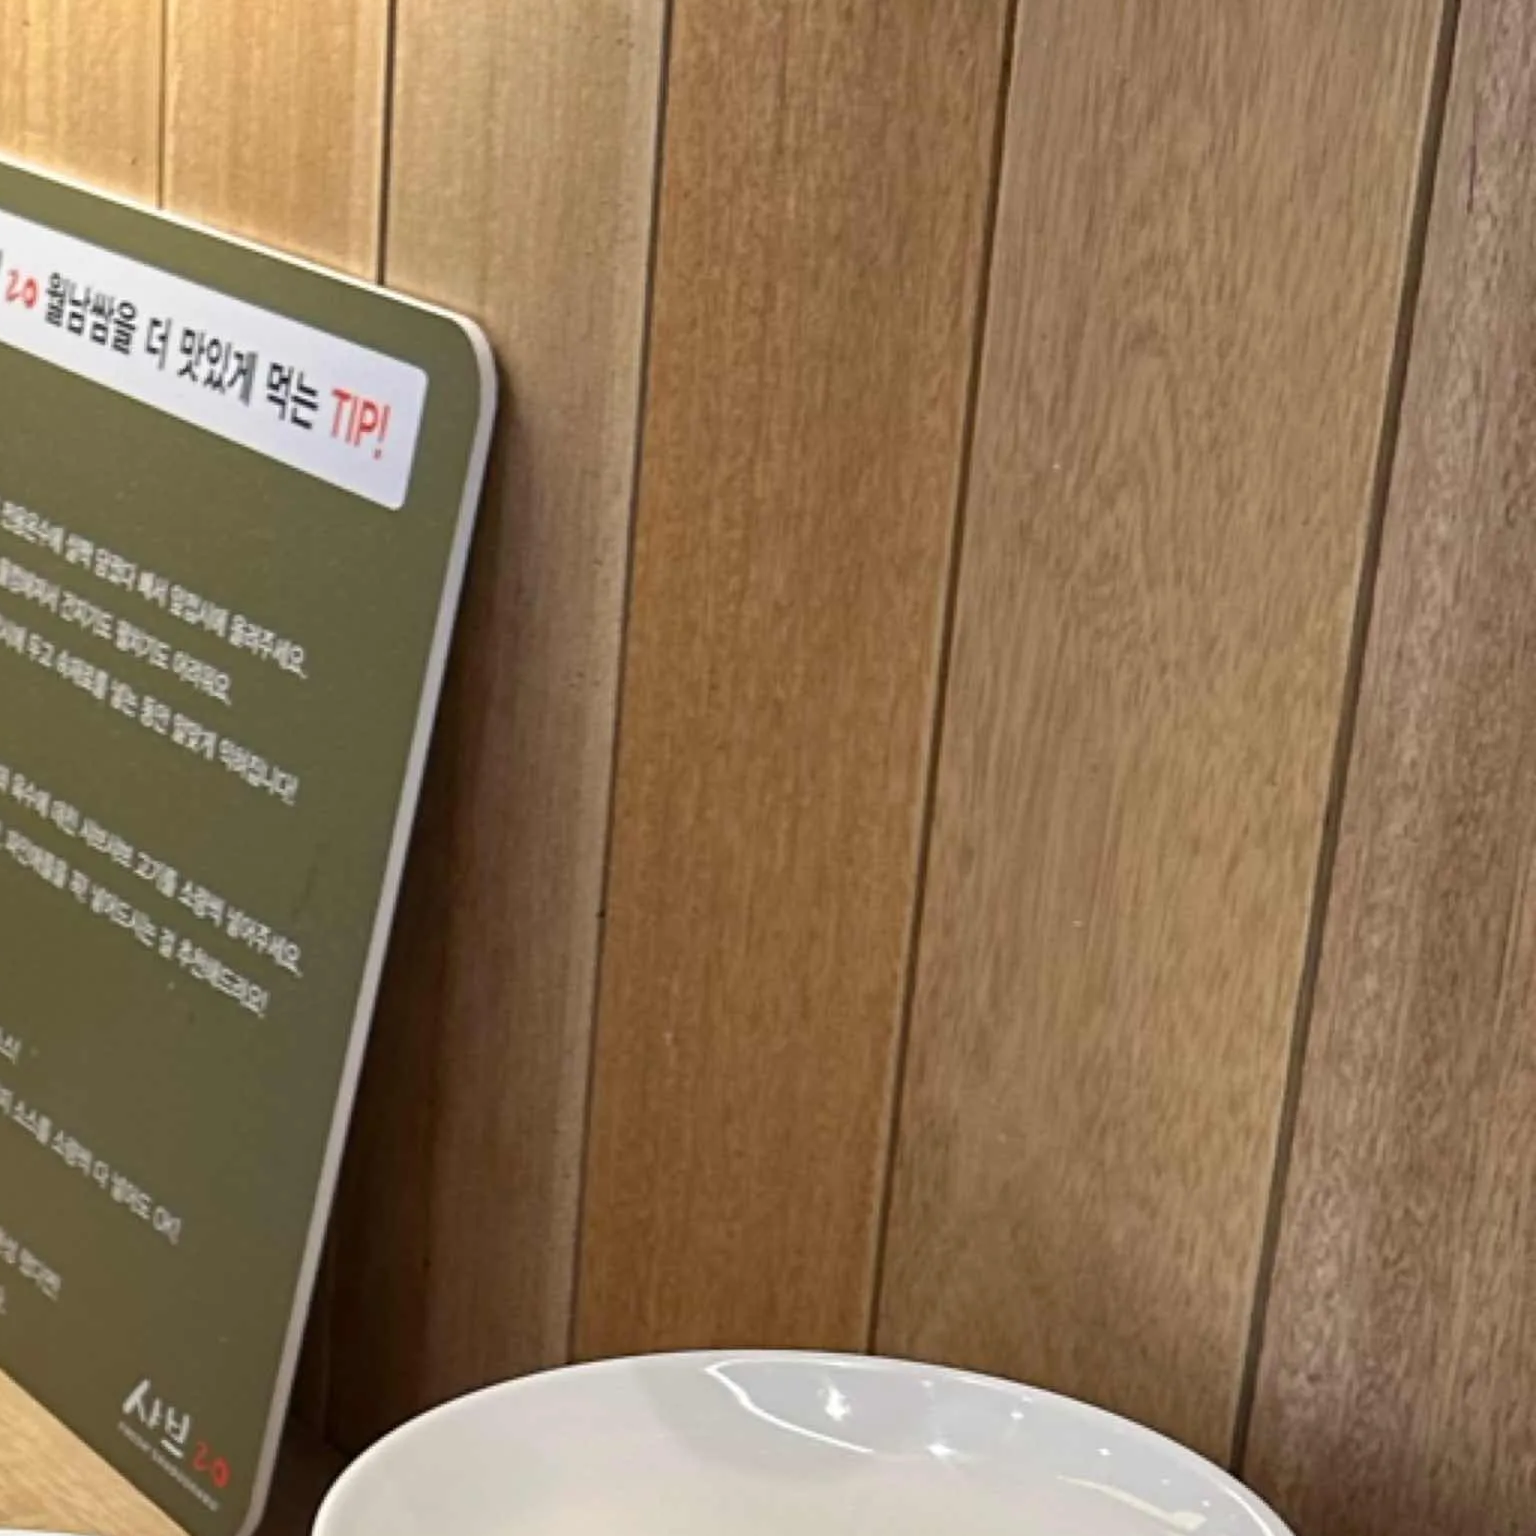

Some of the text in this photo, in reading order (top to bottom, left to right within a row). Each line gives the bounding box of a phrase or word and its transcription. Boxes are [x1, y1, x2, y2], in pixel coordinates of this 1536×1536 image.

[45, 271, 137, 356] 월남쌈을
[145, 317, 171, 371] 더
[178, 328, 257, 406] 맛있게
[267, 361, 320, 430] 먹는
[330, 387, 391, 460] TIP!
